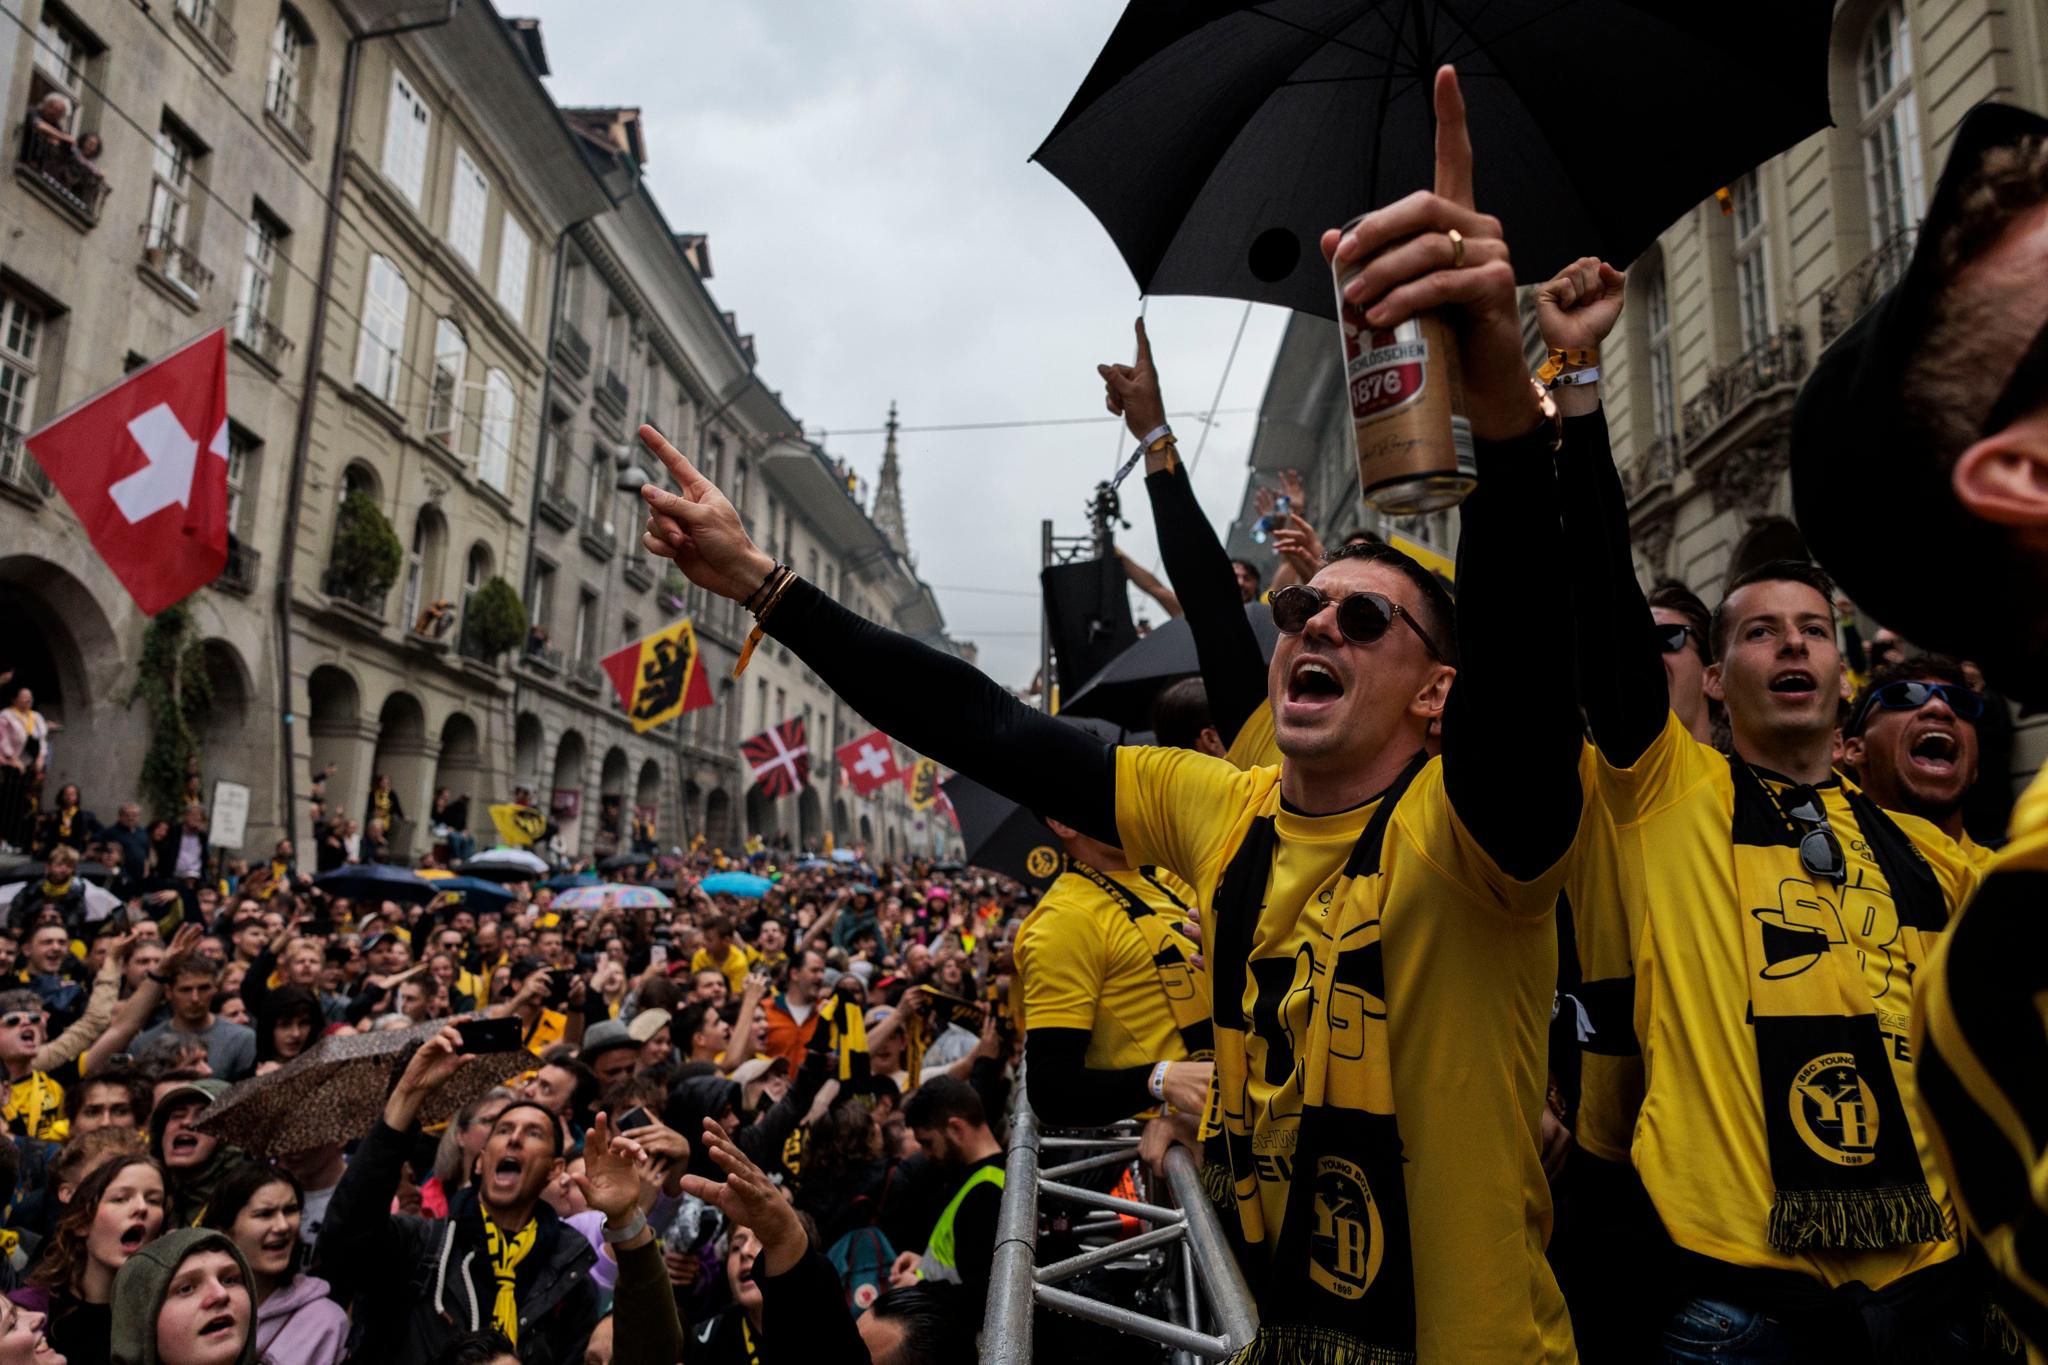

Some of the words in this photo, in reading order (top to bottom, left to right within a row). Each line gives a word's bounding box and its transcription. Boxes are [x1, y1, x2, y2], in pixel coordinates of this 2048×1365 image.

[1351, 369, 1401, 407] 1876
[1073, 860, 1132, 909] MEISTER
[1818, 1055, 1856, 1067] YOUNG
[1320, 1159, 1353, 1176] YOUNG
